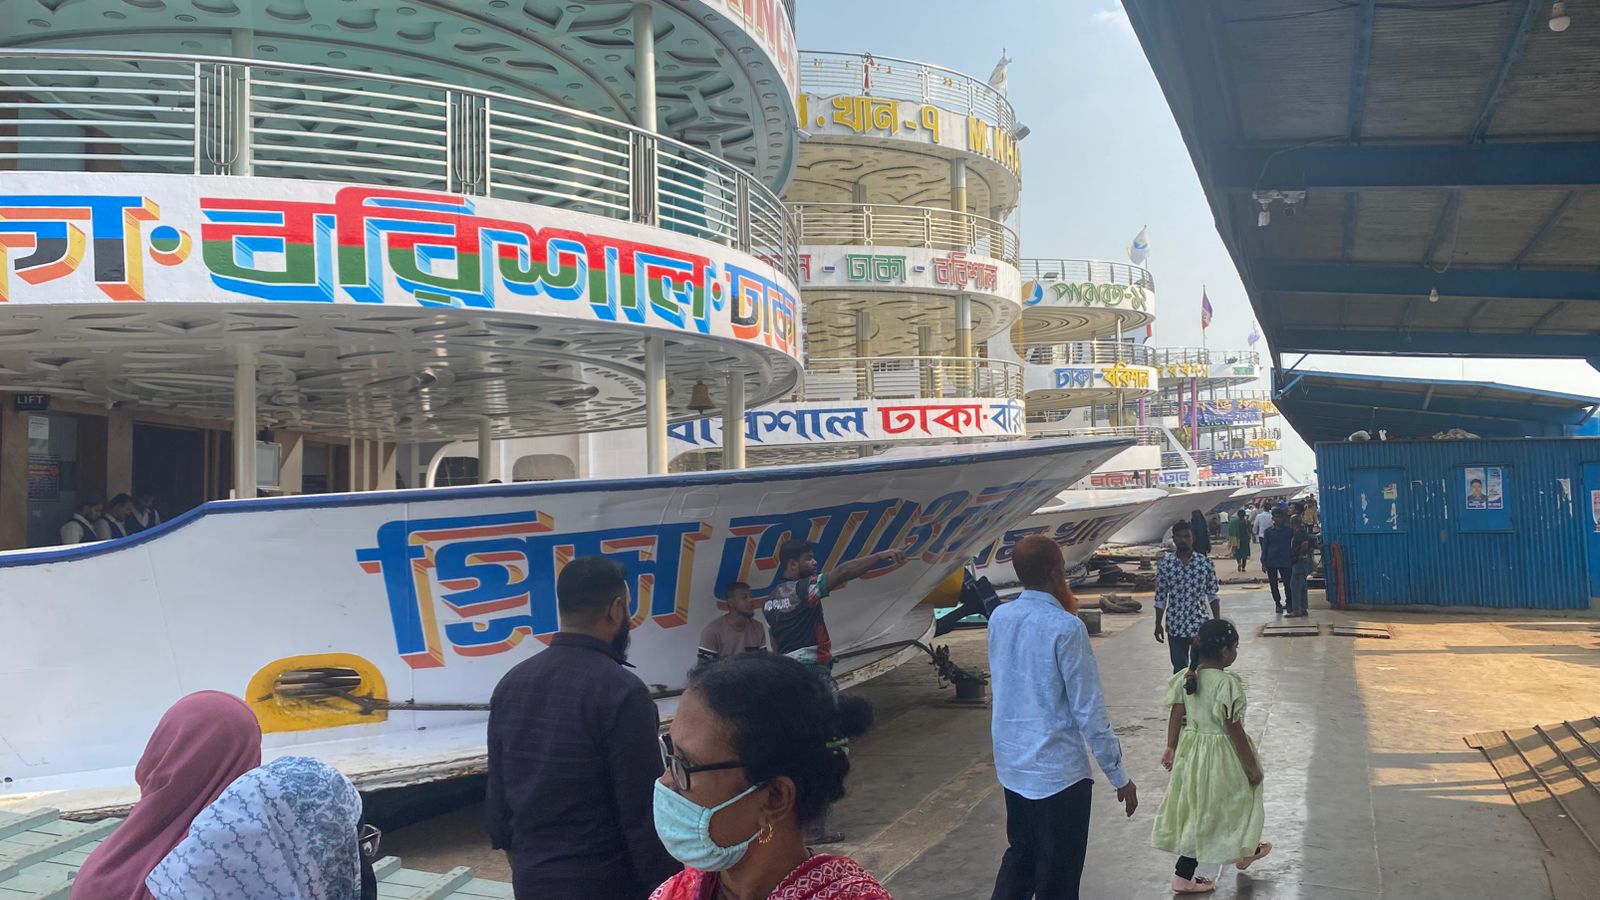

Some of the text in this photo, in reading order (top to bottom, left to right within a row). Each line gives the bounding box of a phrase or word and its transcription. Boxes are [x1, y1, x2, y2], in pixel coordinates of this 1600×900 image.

[200, 186, 715, 334] বরিশাল
[724, 262, 797, 359] ঢাকা
[848, 253, 907, 282] ঢাকা
[934, 251, 998, 290] বরিশাল
[17, 394, 43, 405] LIFT
[877, 404, 985, 436] ঢাকা
